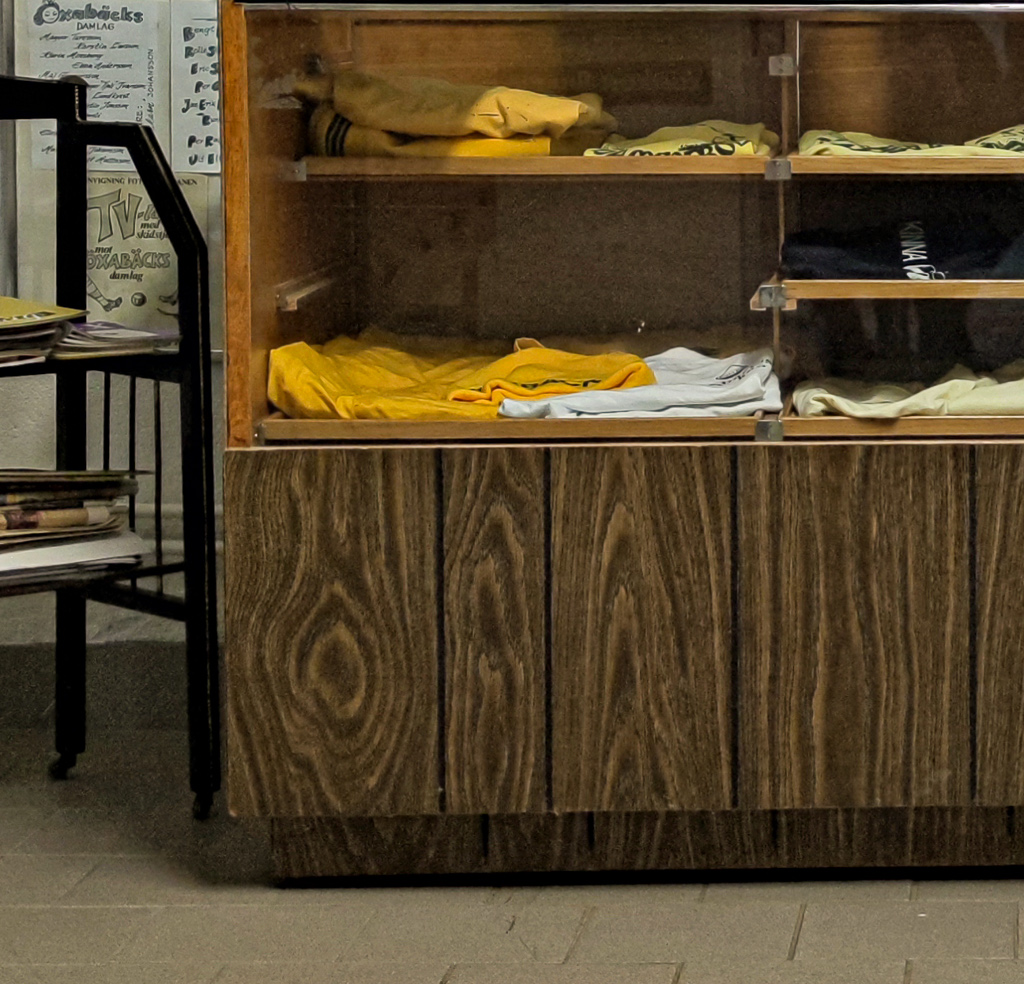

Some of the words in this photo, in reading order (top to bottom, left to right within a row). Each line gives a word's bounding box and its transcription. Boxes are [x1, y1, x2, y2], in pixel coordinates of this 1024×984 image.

[77, 22, 114, 30] DAMLAG
[140, 221, 160, 229] med
[110, 271, 143, 281] damlag
